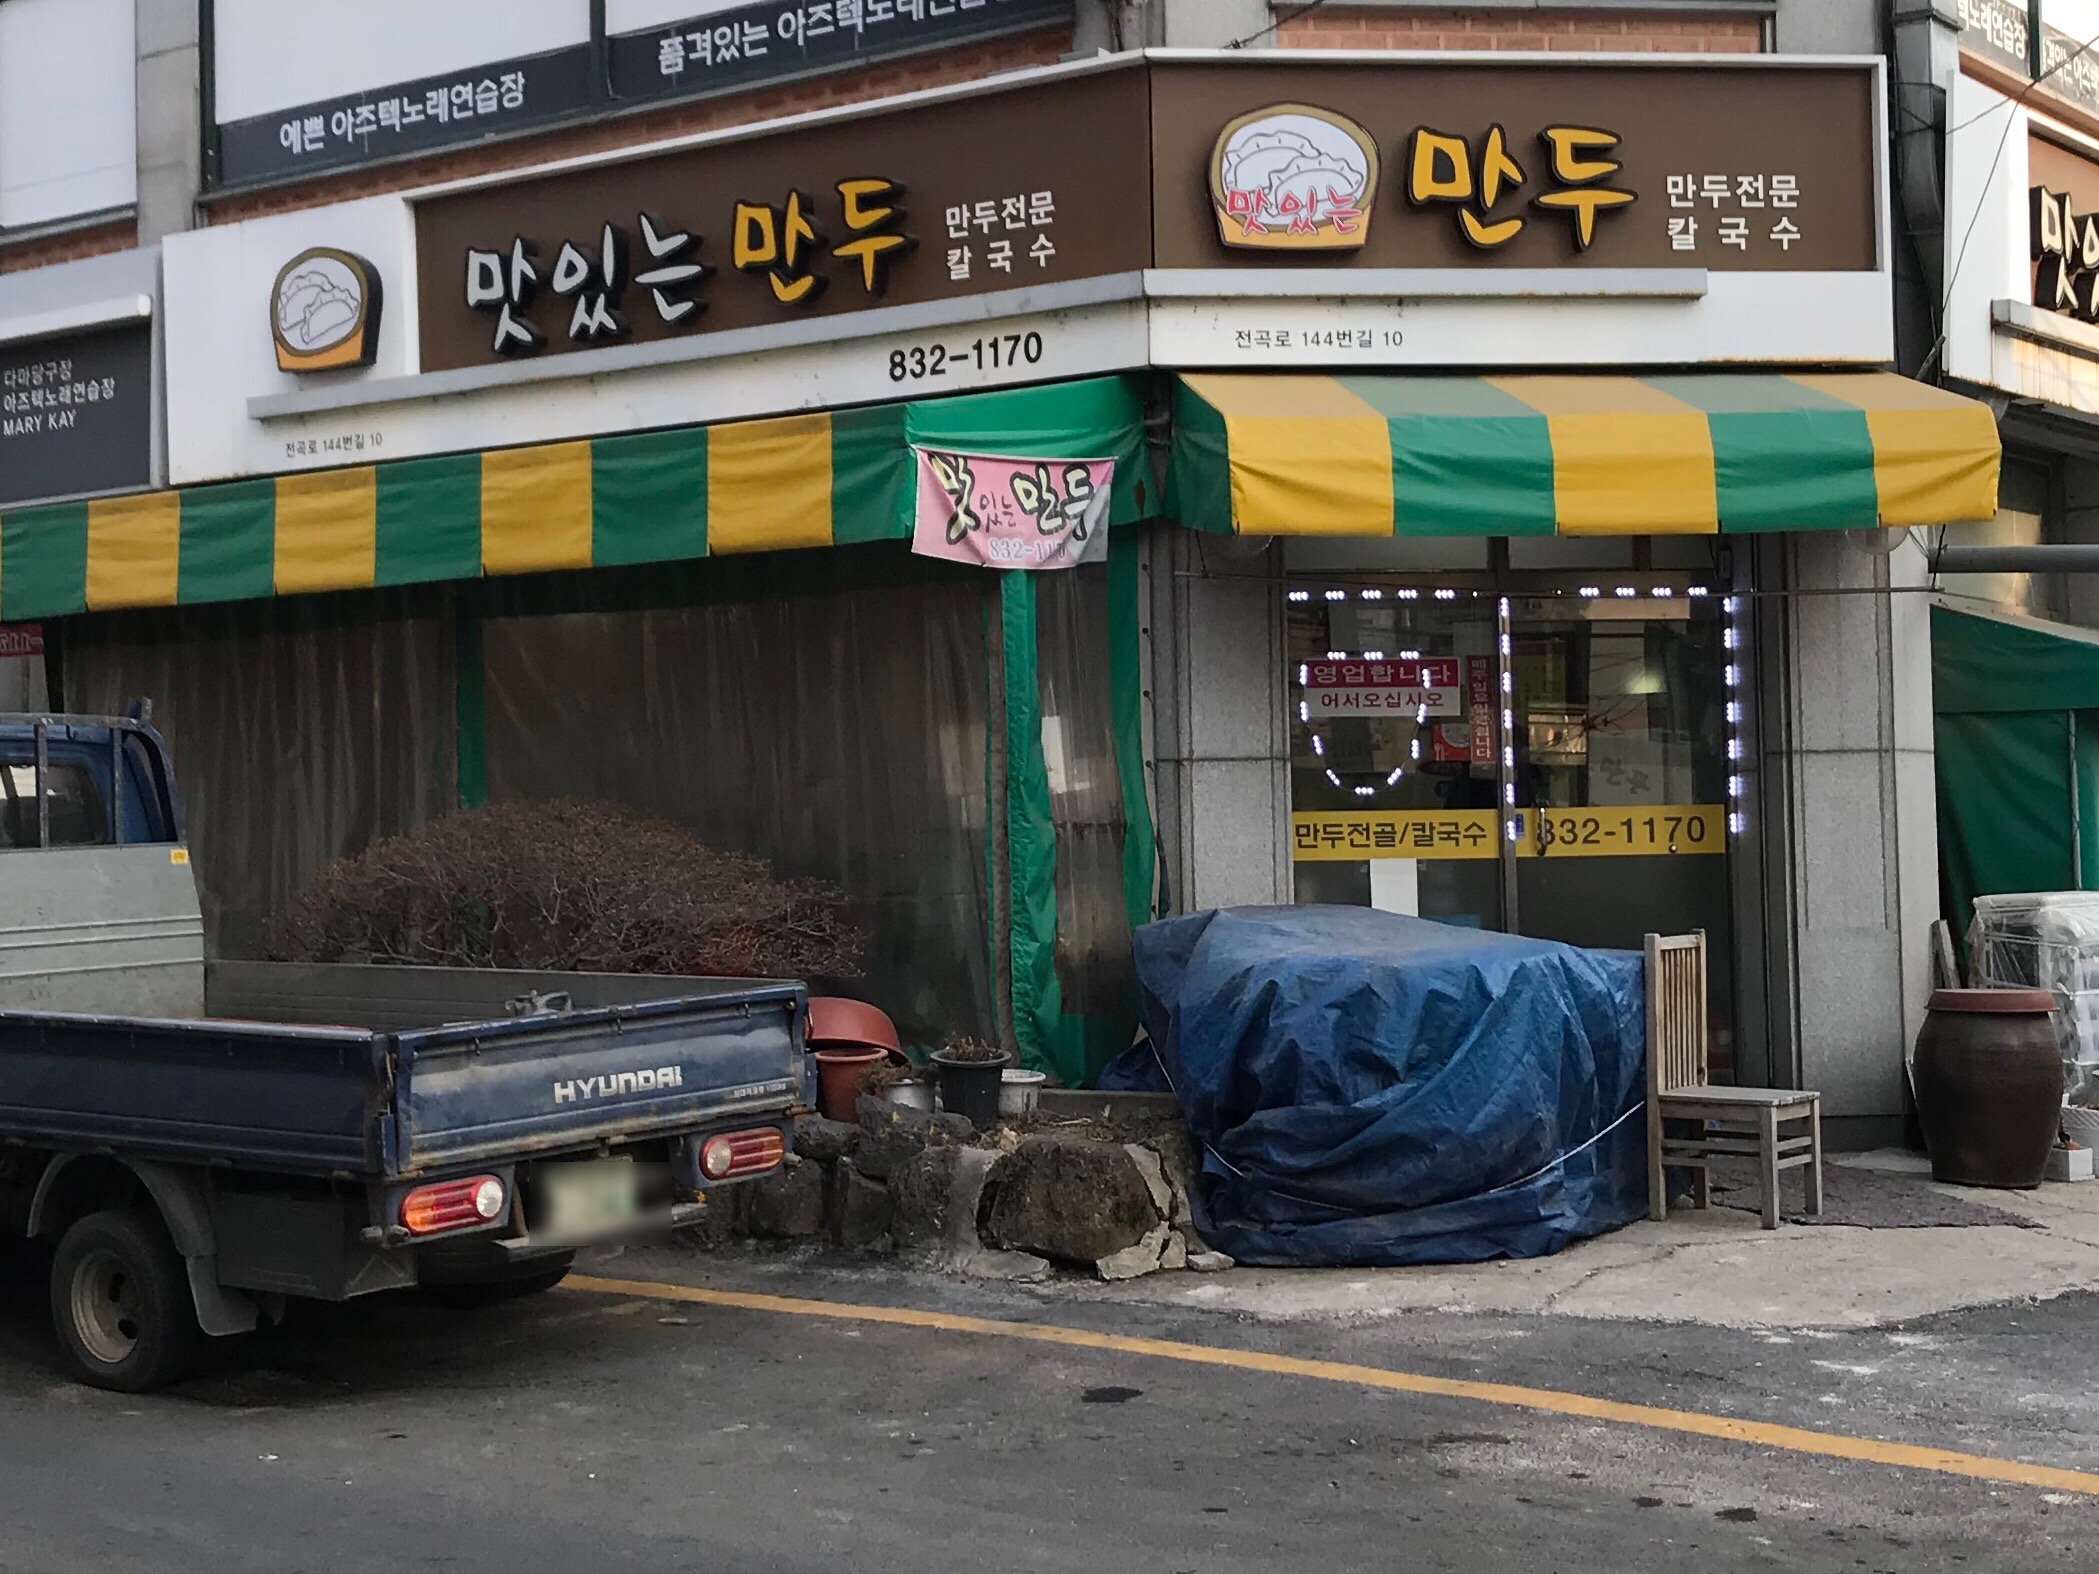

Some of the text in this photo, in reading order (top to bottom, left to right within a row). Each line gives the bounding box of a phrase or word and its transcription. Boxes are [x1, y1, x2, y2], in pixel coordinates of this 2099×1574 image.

[657, 0, 990, 76] 품격있는 아즈텍노래
[279, 71, 526, 155] 예쁜 아즈텍노래연습장
[1226, 122, 1639, 253] 맛있는 만두
[1666, 173, 1801, 209] 만두전문
[945, 190, 1056, 239] 만두전문
[466, 177, 907, 353] 맛있는 만두
[888, 331, 1043, 382] 832-1170
[1234, 329, 1404, 349] 전곡로 144번길 10
[3, 408, 77, 437] MARY KAY
[285, 432, 383, 458] 전곡로 144번길 10
[1313, 664, 1451, 684] 영업합니다
[1321, 691, 1444, 709] 어서오십시오
[1295, 821, 1487, 849] 만두전골/칼국수
[1537, 815, 1706, 846] 832-1170
[553, 1065, 683, 1104] HYUNDAI
